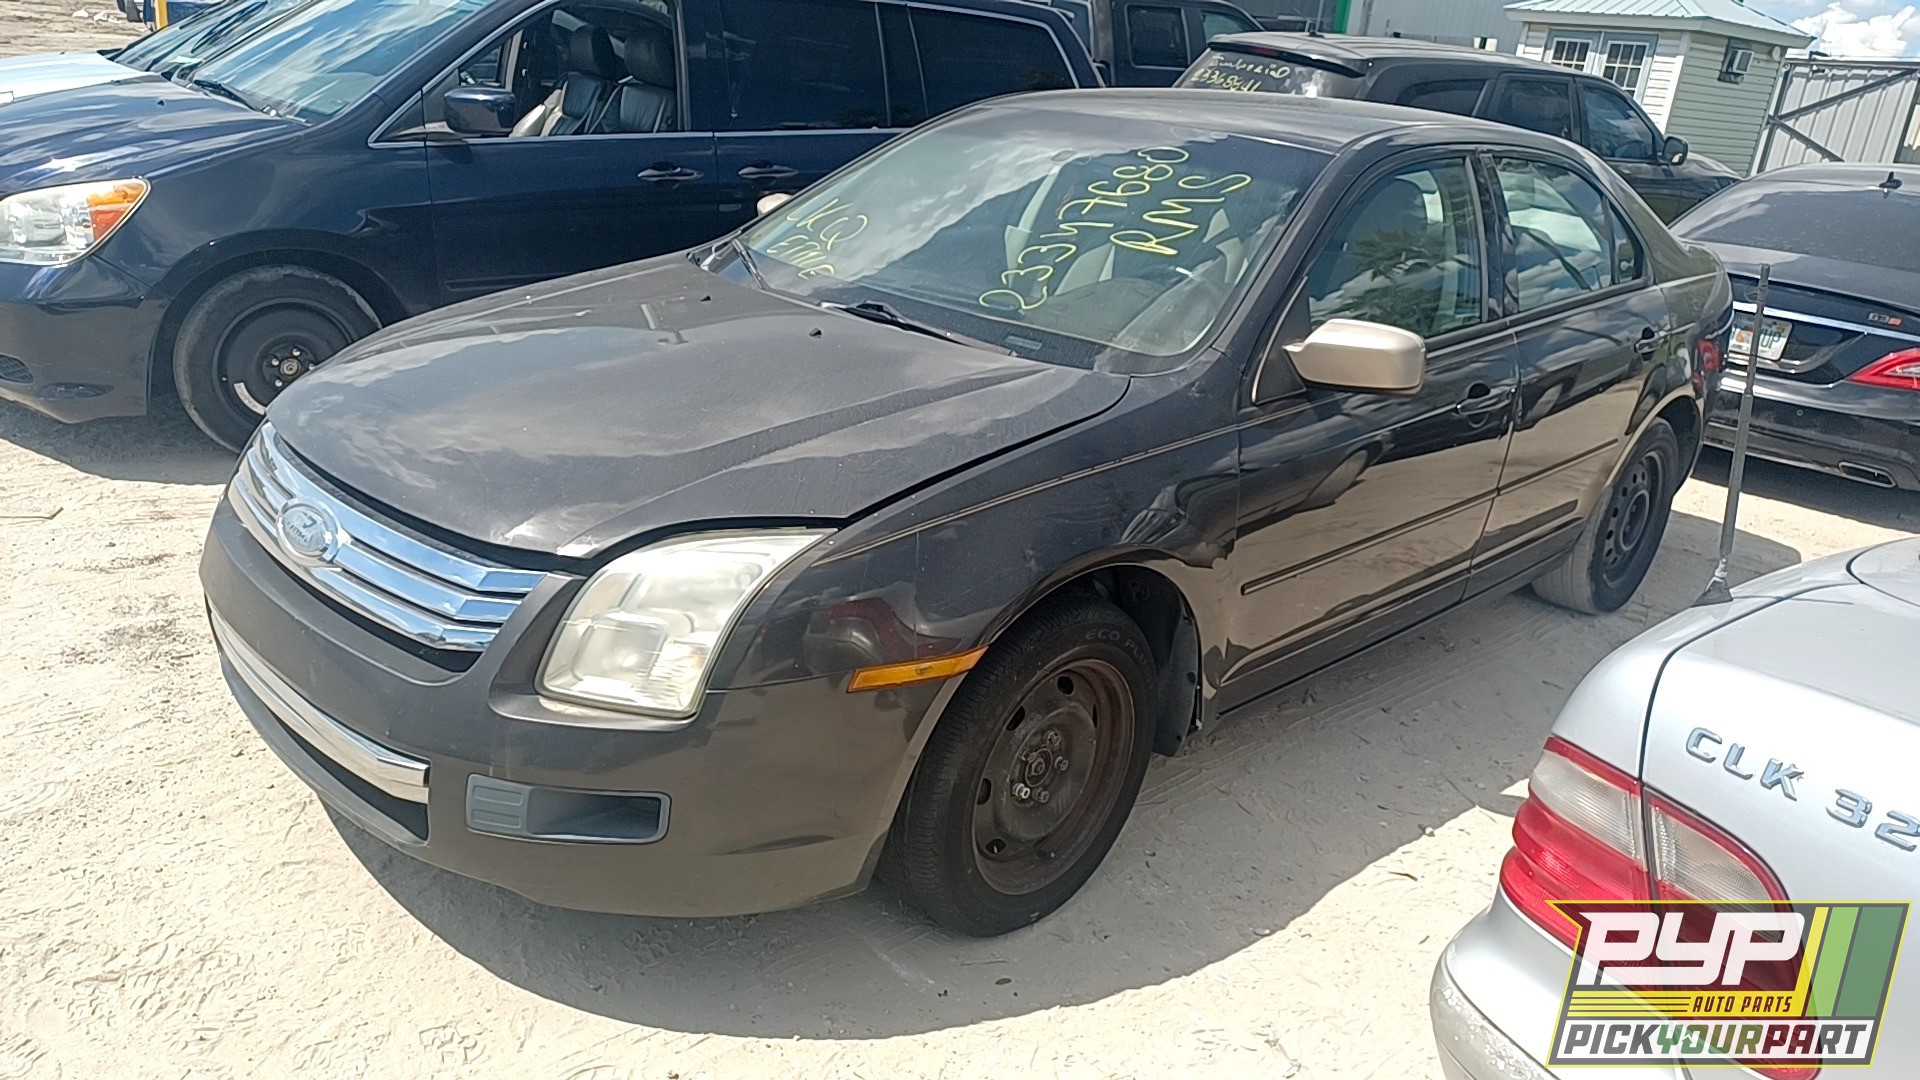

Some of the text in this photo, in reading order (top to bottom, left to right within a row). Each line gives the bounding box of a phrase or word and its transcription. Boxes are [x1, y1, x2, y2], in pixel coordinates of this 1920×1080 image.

[786, 198, 868, 251] LKQ
[1110, 174, 1252, 255] RMS
[1686, 726, 1805, 802] CLK
